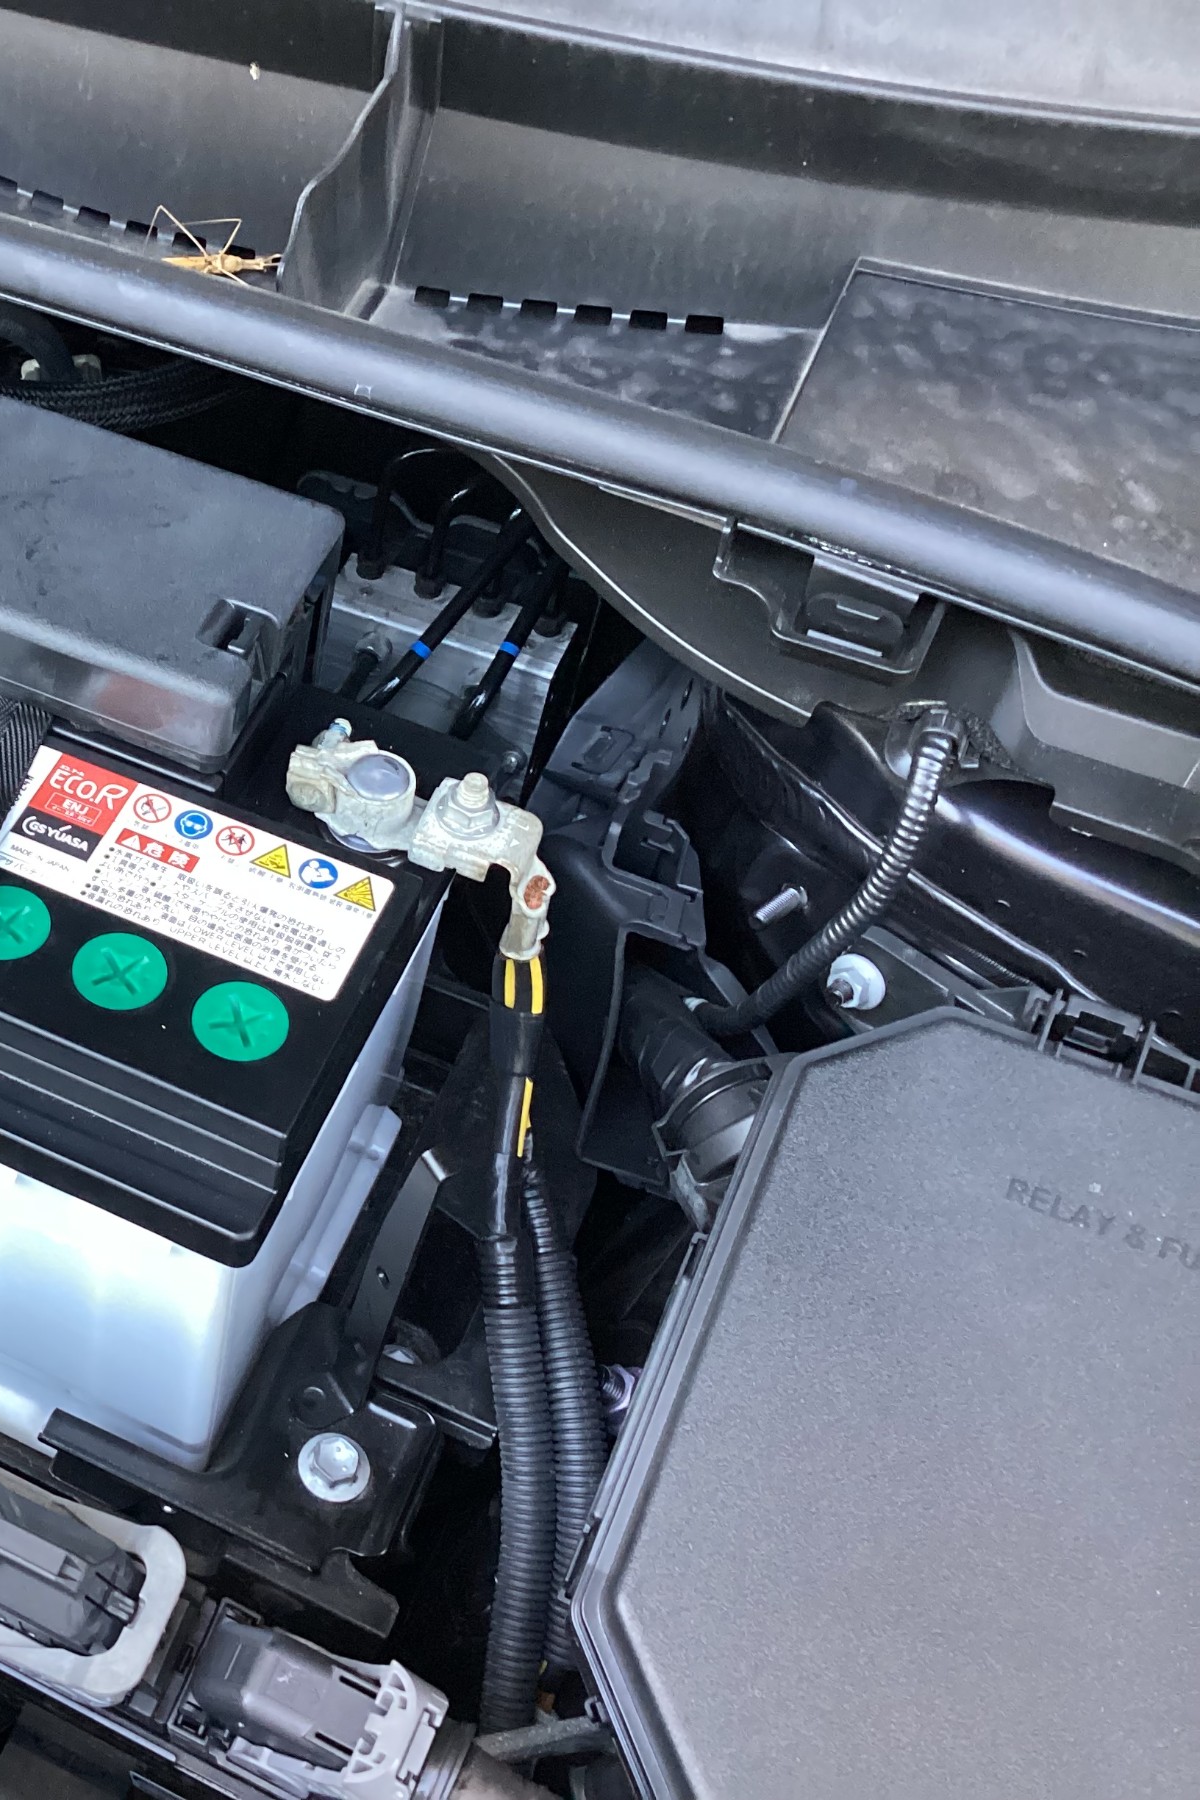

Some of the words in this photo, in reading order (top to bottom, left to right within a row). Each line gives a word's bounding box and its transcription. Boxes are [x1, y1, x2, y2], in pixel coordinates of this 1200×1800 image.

[63, 799, 88, 815] ENJ
[141, 839, 192, 868] 危険
[1007, 1178, 1115, 1235] RELAY
